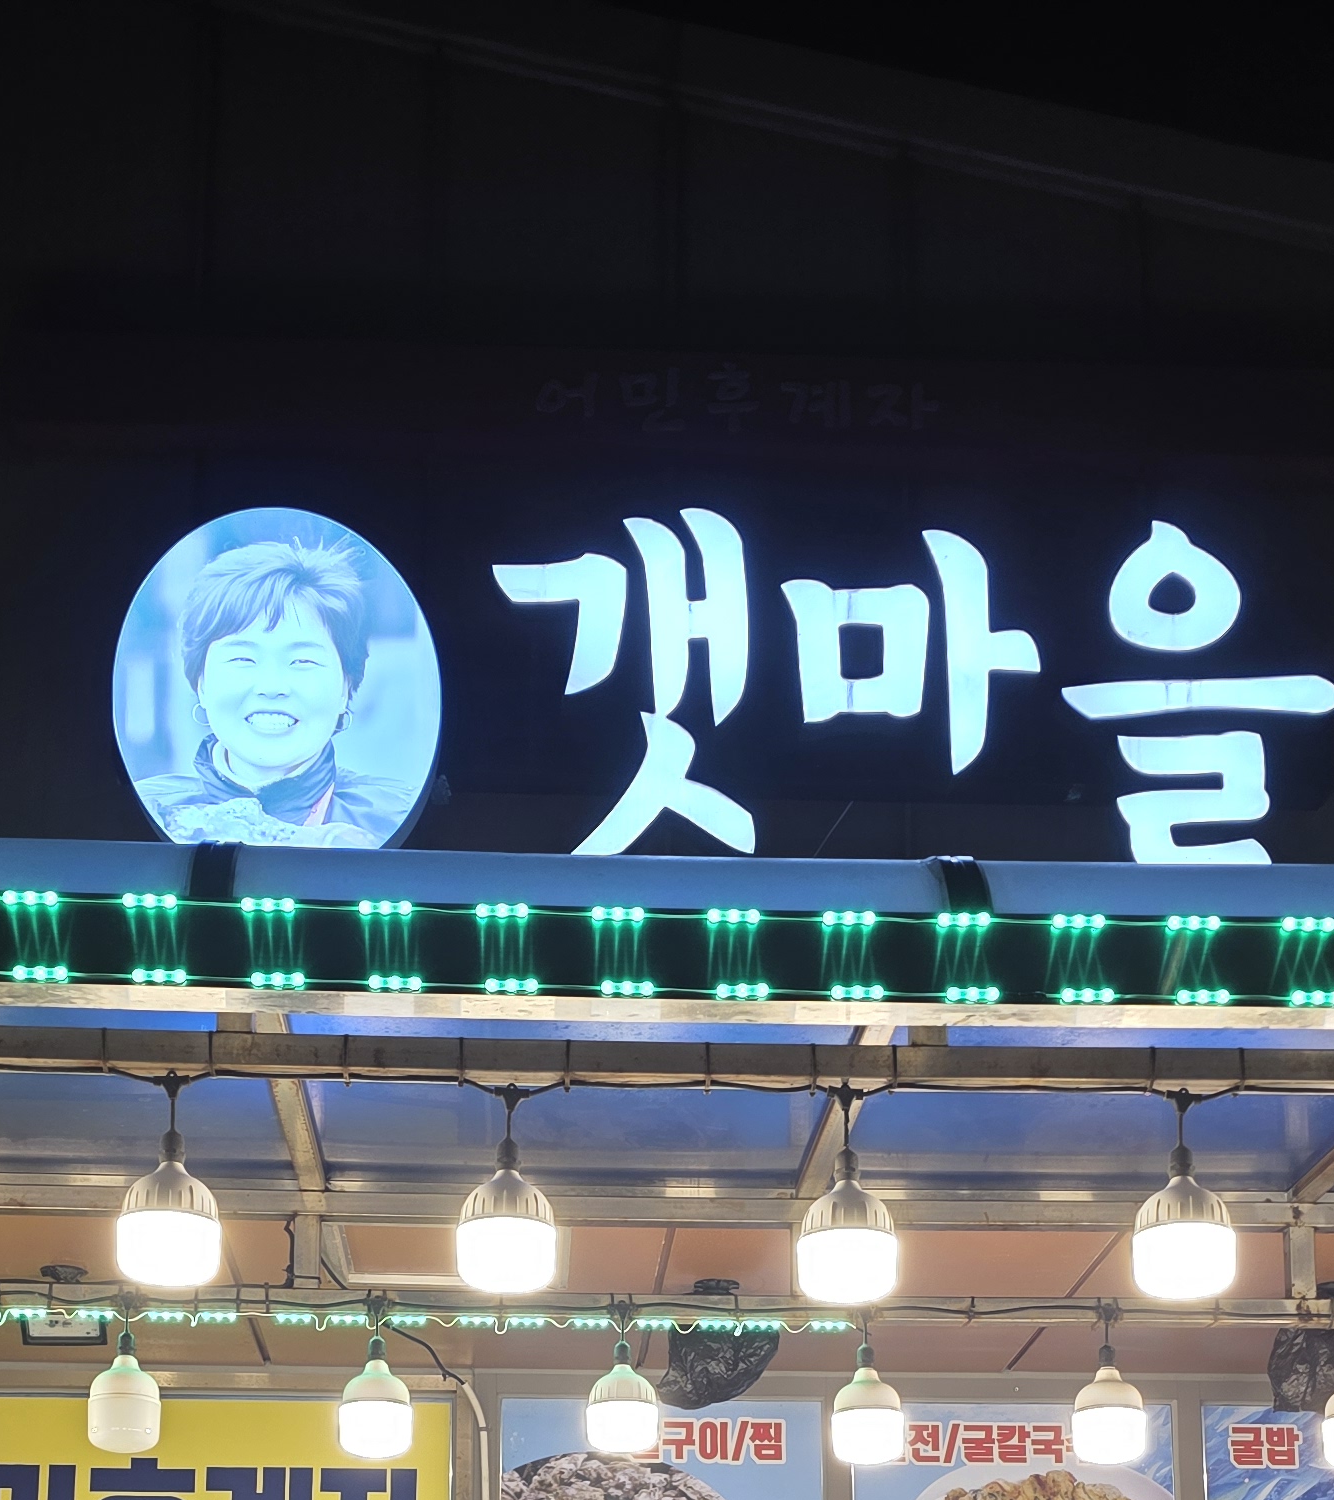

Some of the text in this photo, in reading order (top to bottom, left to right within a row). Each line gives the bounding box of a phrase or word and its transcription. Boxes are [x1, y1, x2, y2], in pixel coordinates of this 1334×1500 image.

[534, 362, 940, 434] 어민후계자
[632, 1418, 784, 1464] 구이/찜
[891, 1421, 1073, 1465] 전/굴칼국
[1229, 1425, 1302, 1468] 굴밥
